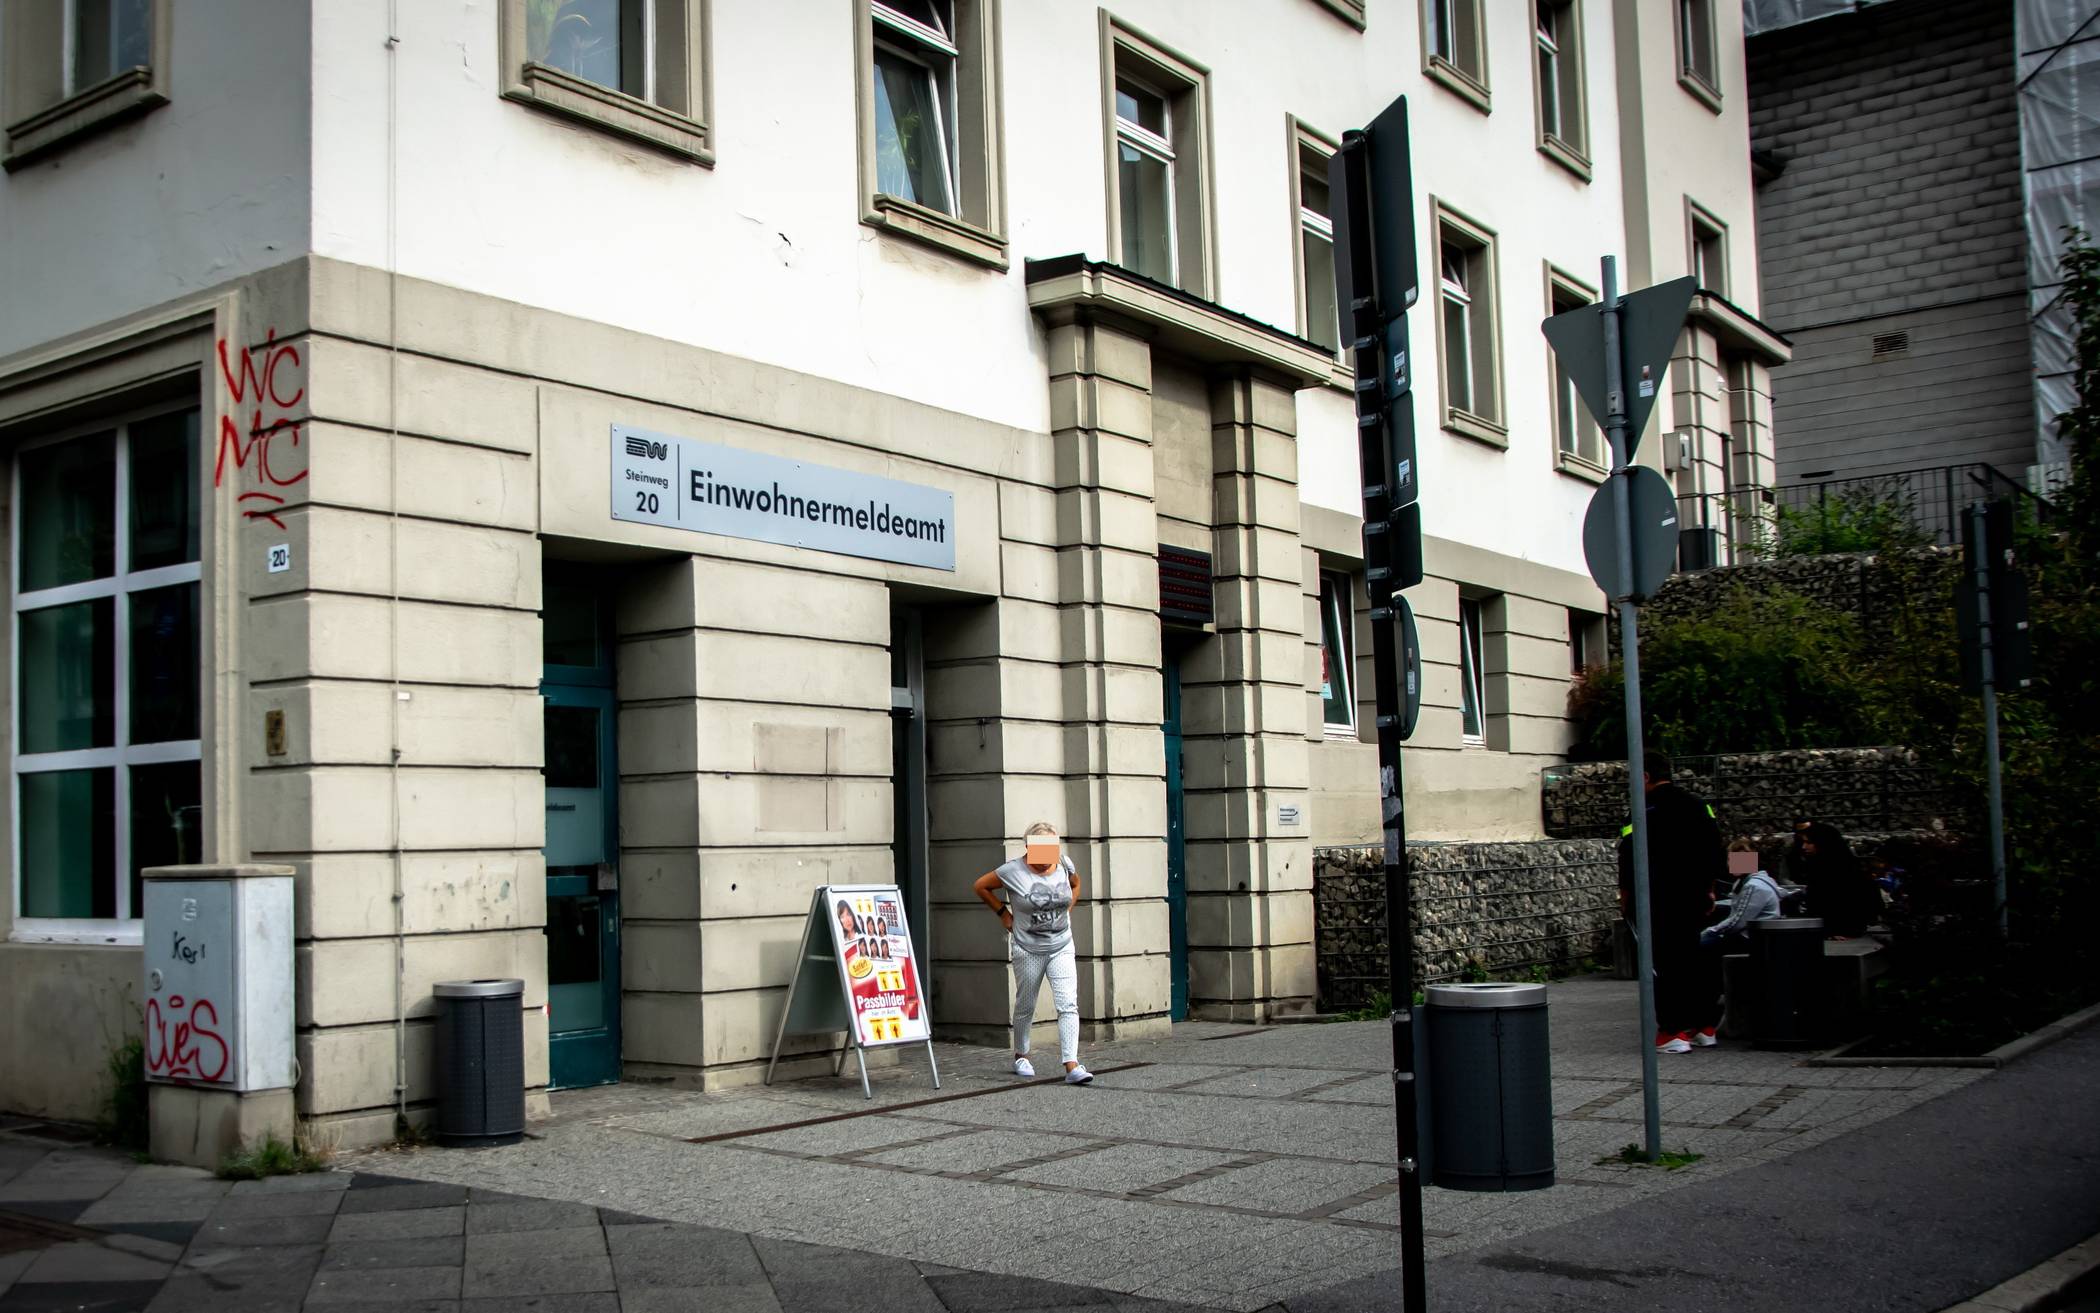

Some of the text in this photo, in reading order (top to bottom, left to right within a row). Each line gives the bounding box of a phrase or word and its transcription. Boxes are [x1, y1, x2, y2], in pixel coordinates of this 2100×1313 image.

[626, 468, 669, 490] Steinweg
[636, 490, 659, 514] 20
[691, 469, 945, 543] Einwohnermeldeamt
[272, 549, 287, 567] 20
[856, 992, 905, 1010] Passbilder
